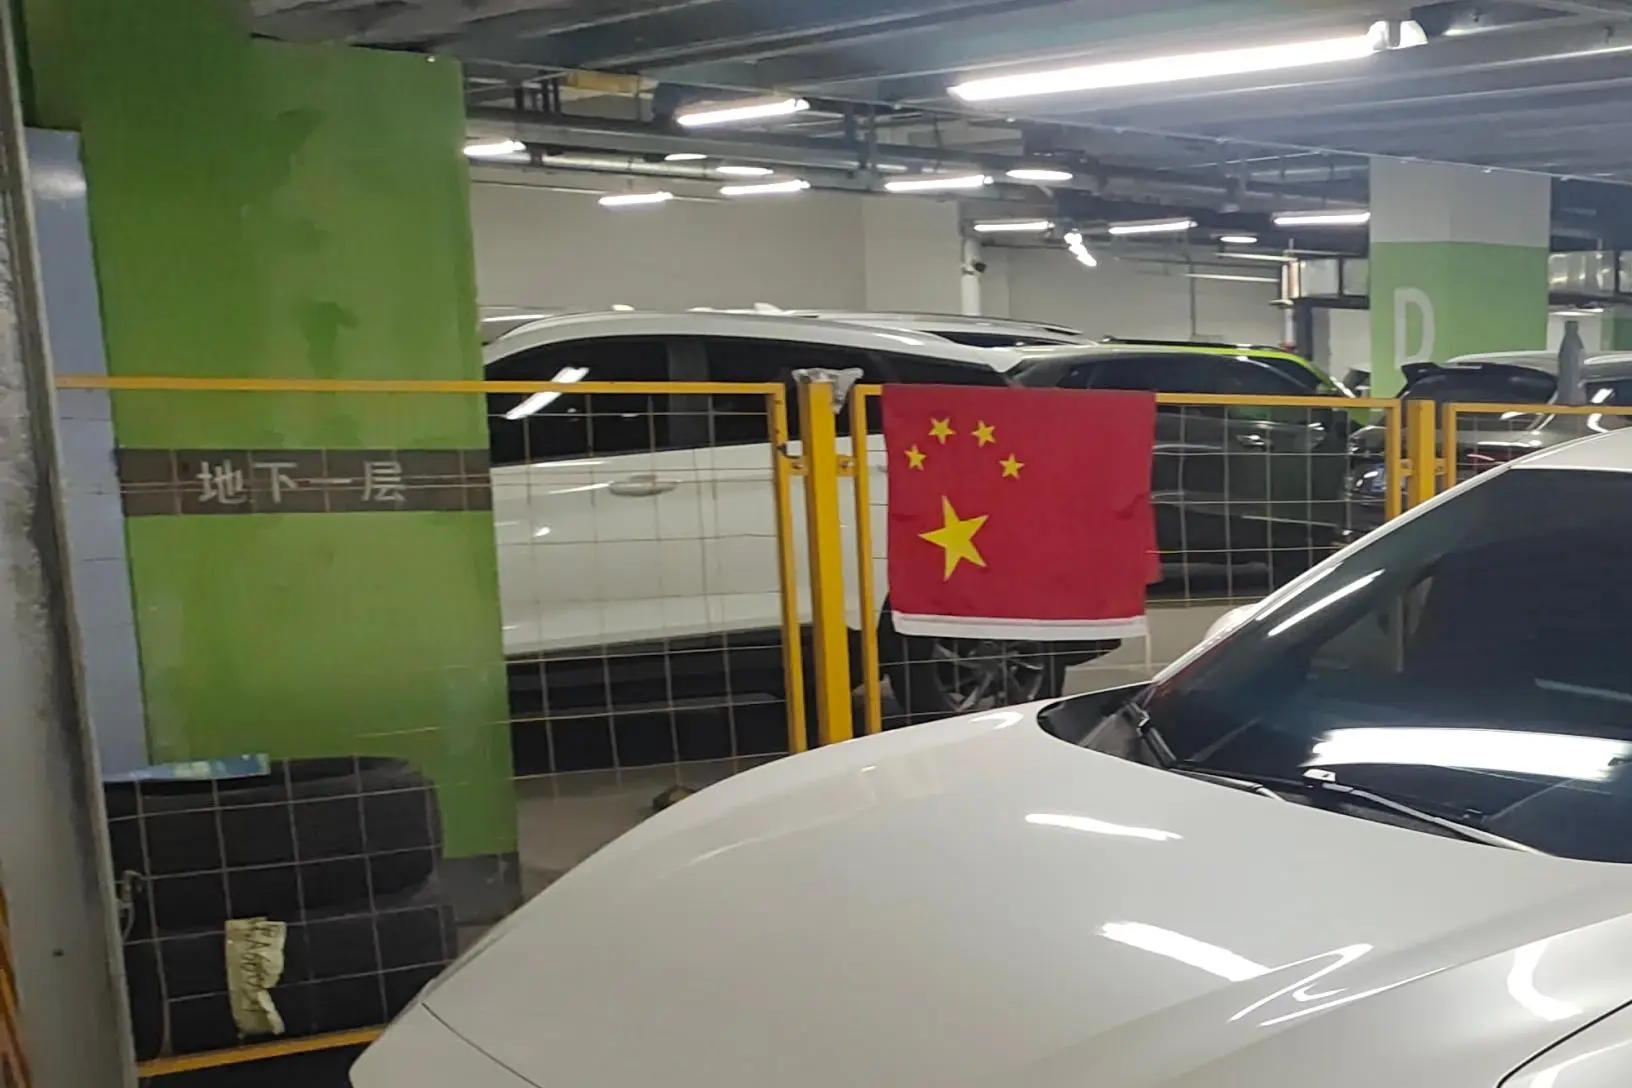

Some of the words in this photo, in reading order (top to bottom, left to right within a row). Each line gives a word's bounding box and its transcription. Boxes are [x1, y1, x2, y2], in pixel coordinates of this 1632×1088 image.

[1394, 287, 1435, 369] D
[196, 459, 407, 504] 地下一层
